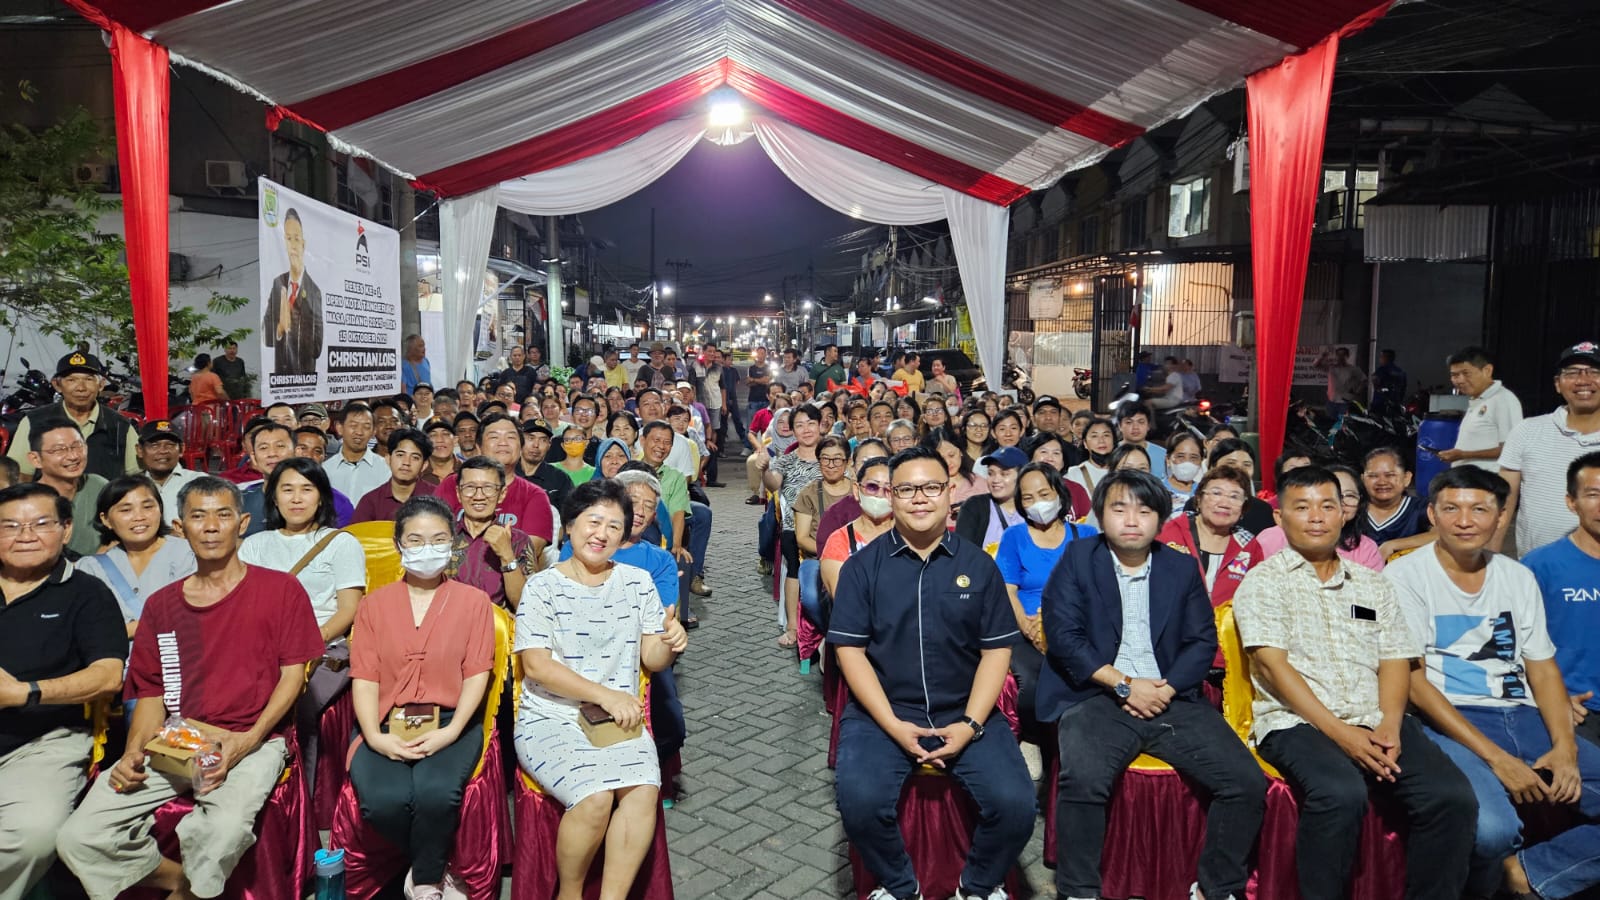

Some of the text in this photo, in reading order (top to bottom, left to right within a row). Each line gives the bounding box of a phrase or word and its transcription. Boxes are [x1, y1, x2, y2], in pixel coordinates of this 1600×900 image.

[356, 253, 370, 268] PSI
[326, 293, 343, 307] DPRD
[344, 297, 362, 311] KOTA
[326, 311, 345, 325] MASA
[345, 314, 368, 328] SIDANG
[338, 330, 347, 343] 15
[348, 331, 376, 344] OKTOBER
[329, 351, 396, 367] CHRISTIAN LOIS
[270, 374, 317, 385] CHRISTIAN LOIS
